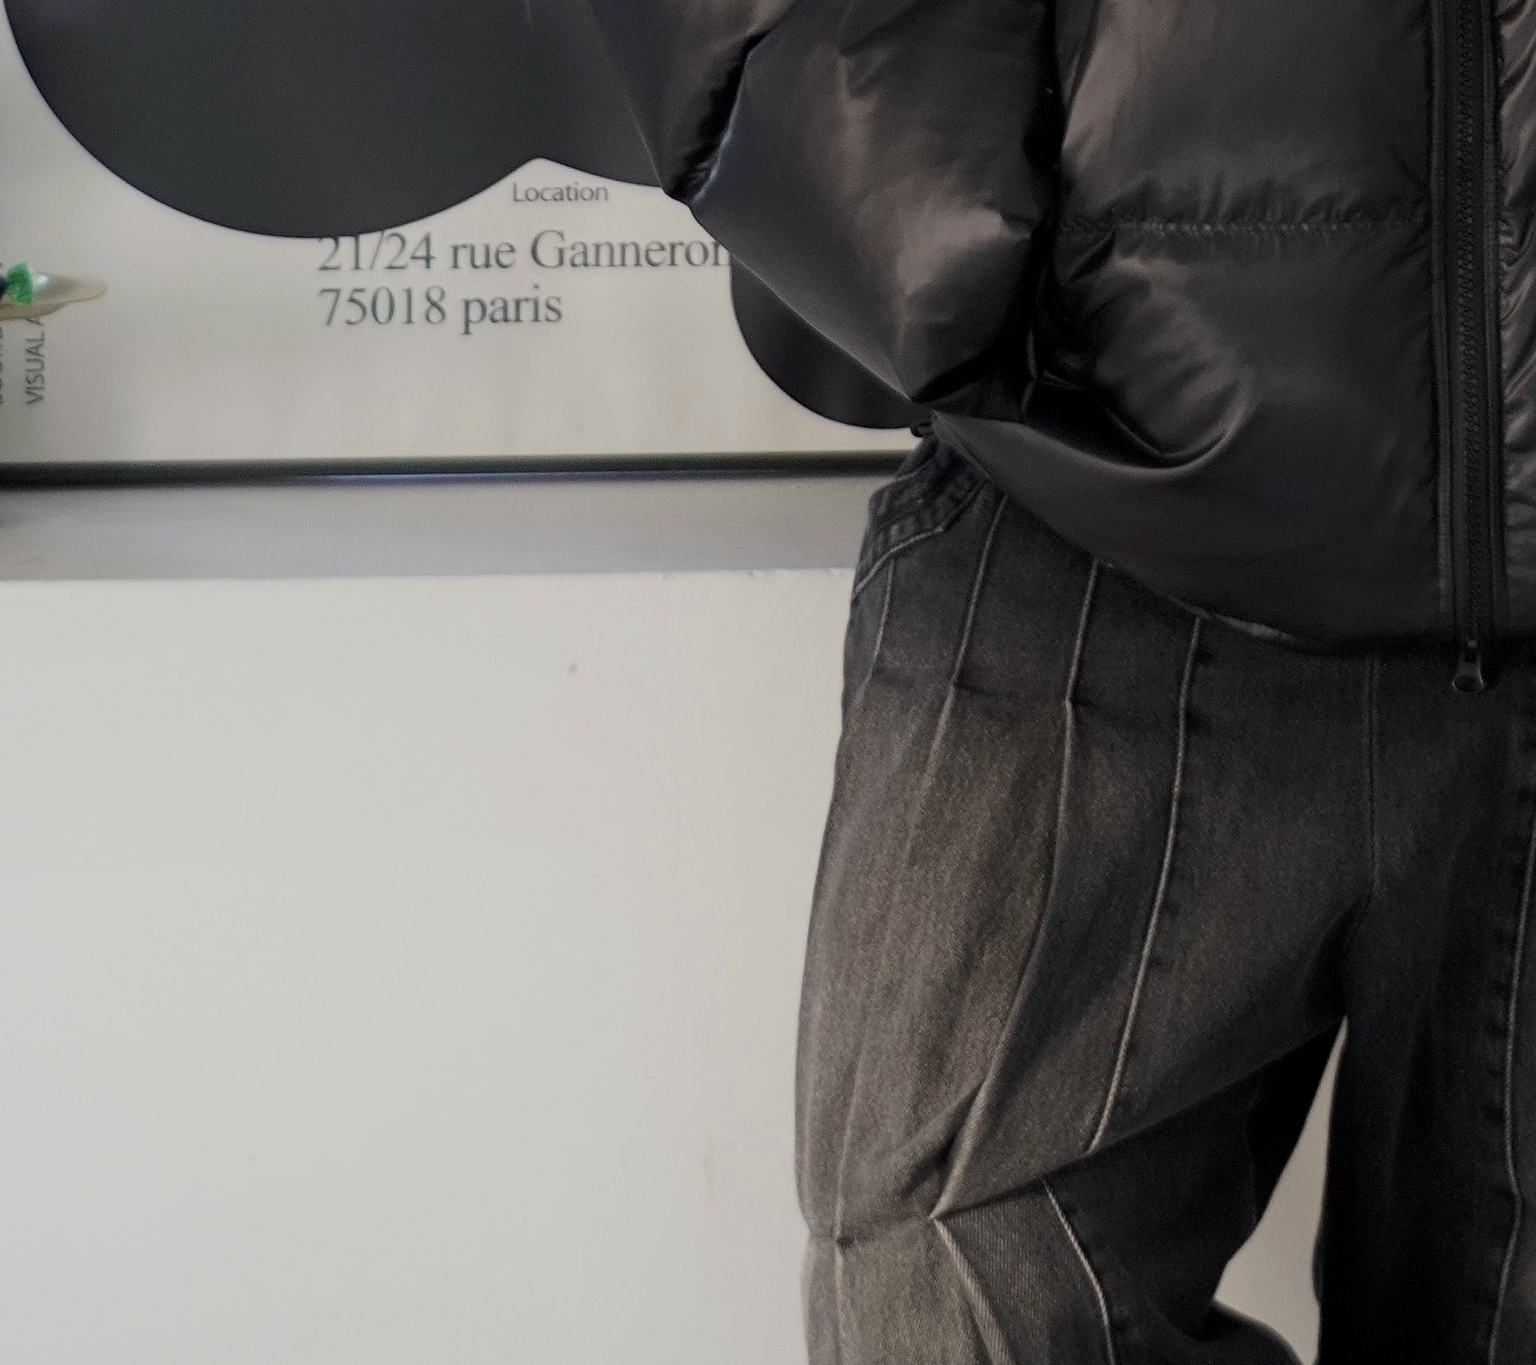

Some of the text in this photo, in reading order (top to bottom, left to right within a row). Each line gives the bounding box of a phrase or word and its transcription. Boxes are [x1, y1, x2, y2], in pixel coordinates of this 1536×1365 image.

[512, 180, 609, 204] Location
[318, 230, 435, 271] 21/24
[450, 240, 517, 270] rue
[318, 283, 563, 336] 75018 paris
[25, 331, 45, 405] VISUAL
